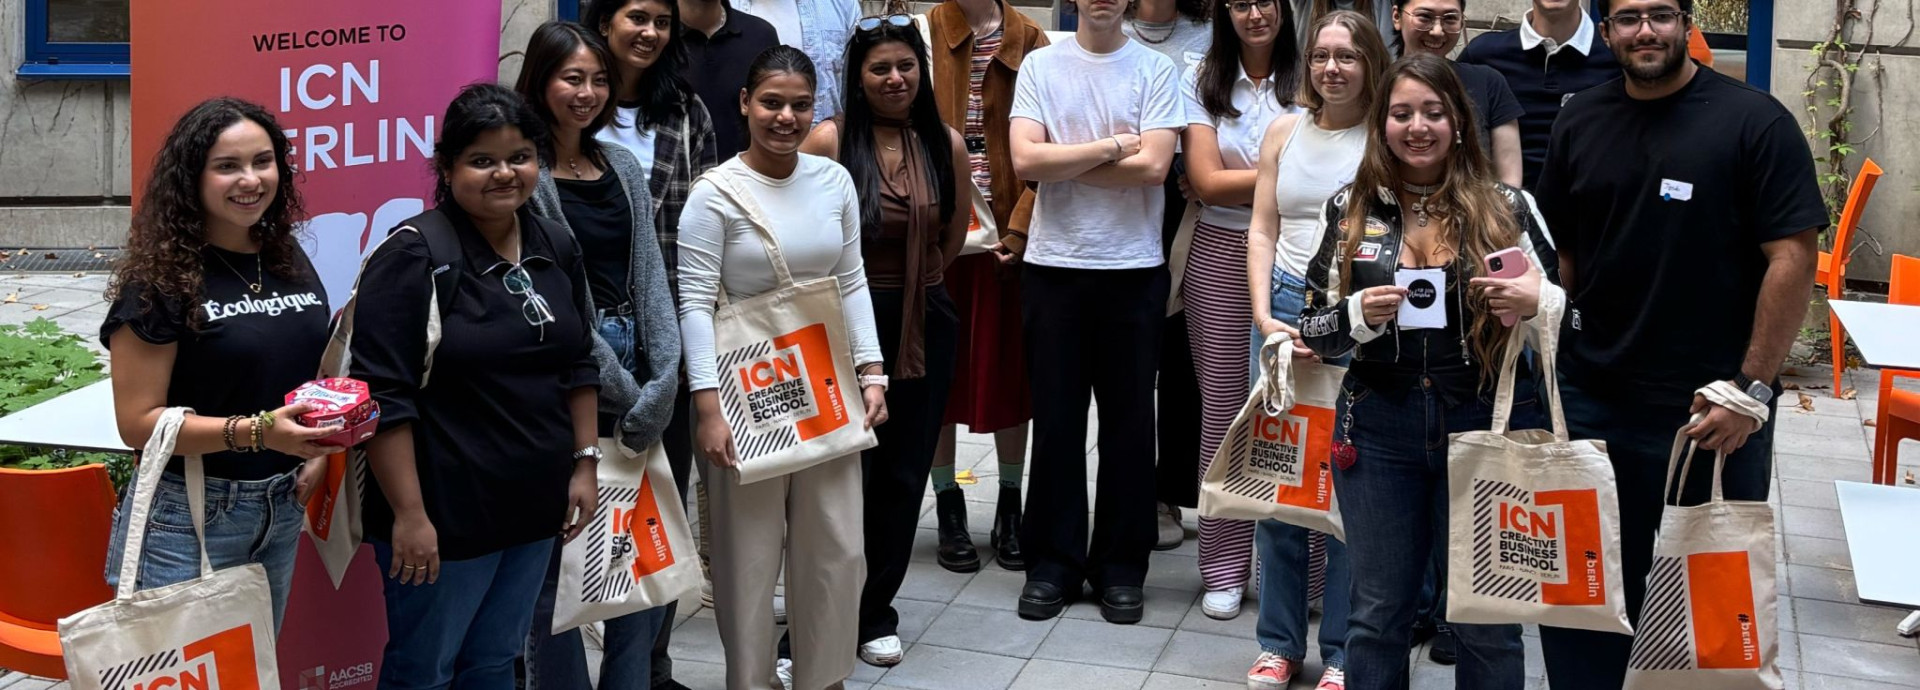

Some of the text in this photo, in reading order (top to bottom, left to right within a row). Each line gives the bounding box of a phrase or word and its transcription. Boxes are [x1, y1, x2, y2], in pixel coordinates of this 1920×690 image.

[253, 23, 406, 52] WELCOME TO
[280, 59, 379, 113] ICN
[282, 114, 435, 174] ERLIN
[739, 353, 801, 394] ICN
[747, 378, 804, 402] CREACTIVE
[749, 386, 806, 412] BUSINESS
[752, 397, 809, 423] SCHOOL
[1253, 414, 1300, 446] ICN
[1251, 447, 1297, 464] BUSINESS
[1253, 439, 1299, 455] CREACTIVE
[1249, 457, 1296, 475] SCHOOL
[1499, 502, 1557, 538] ICN
[1500, 530, 1557, 549] CREACTIVE
[1500, 540, 1558, 559] BUSINESS
[1500, 551, 1559, 571] SCHOOL
[329, 662, 373, 683] AACSB
